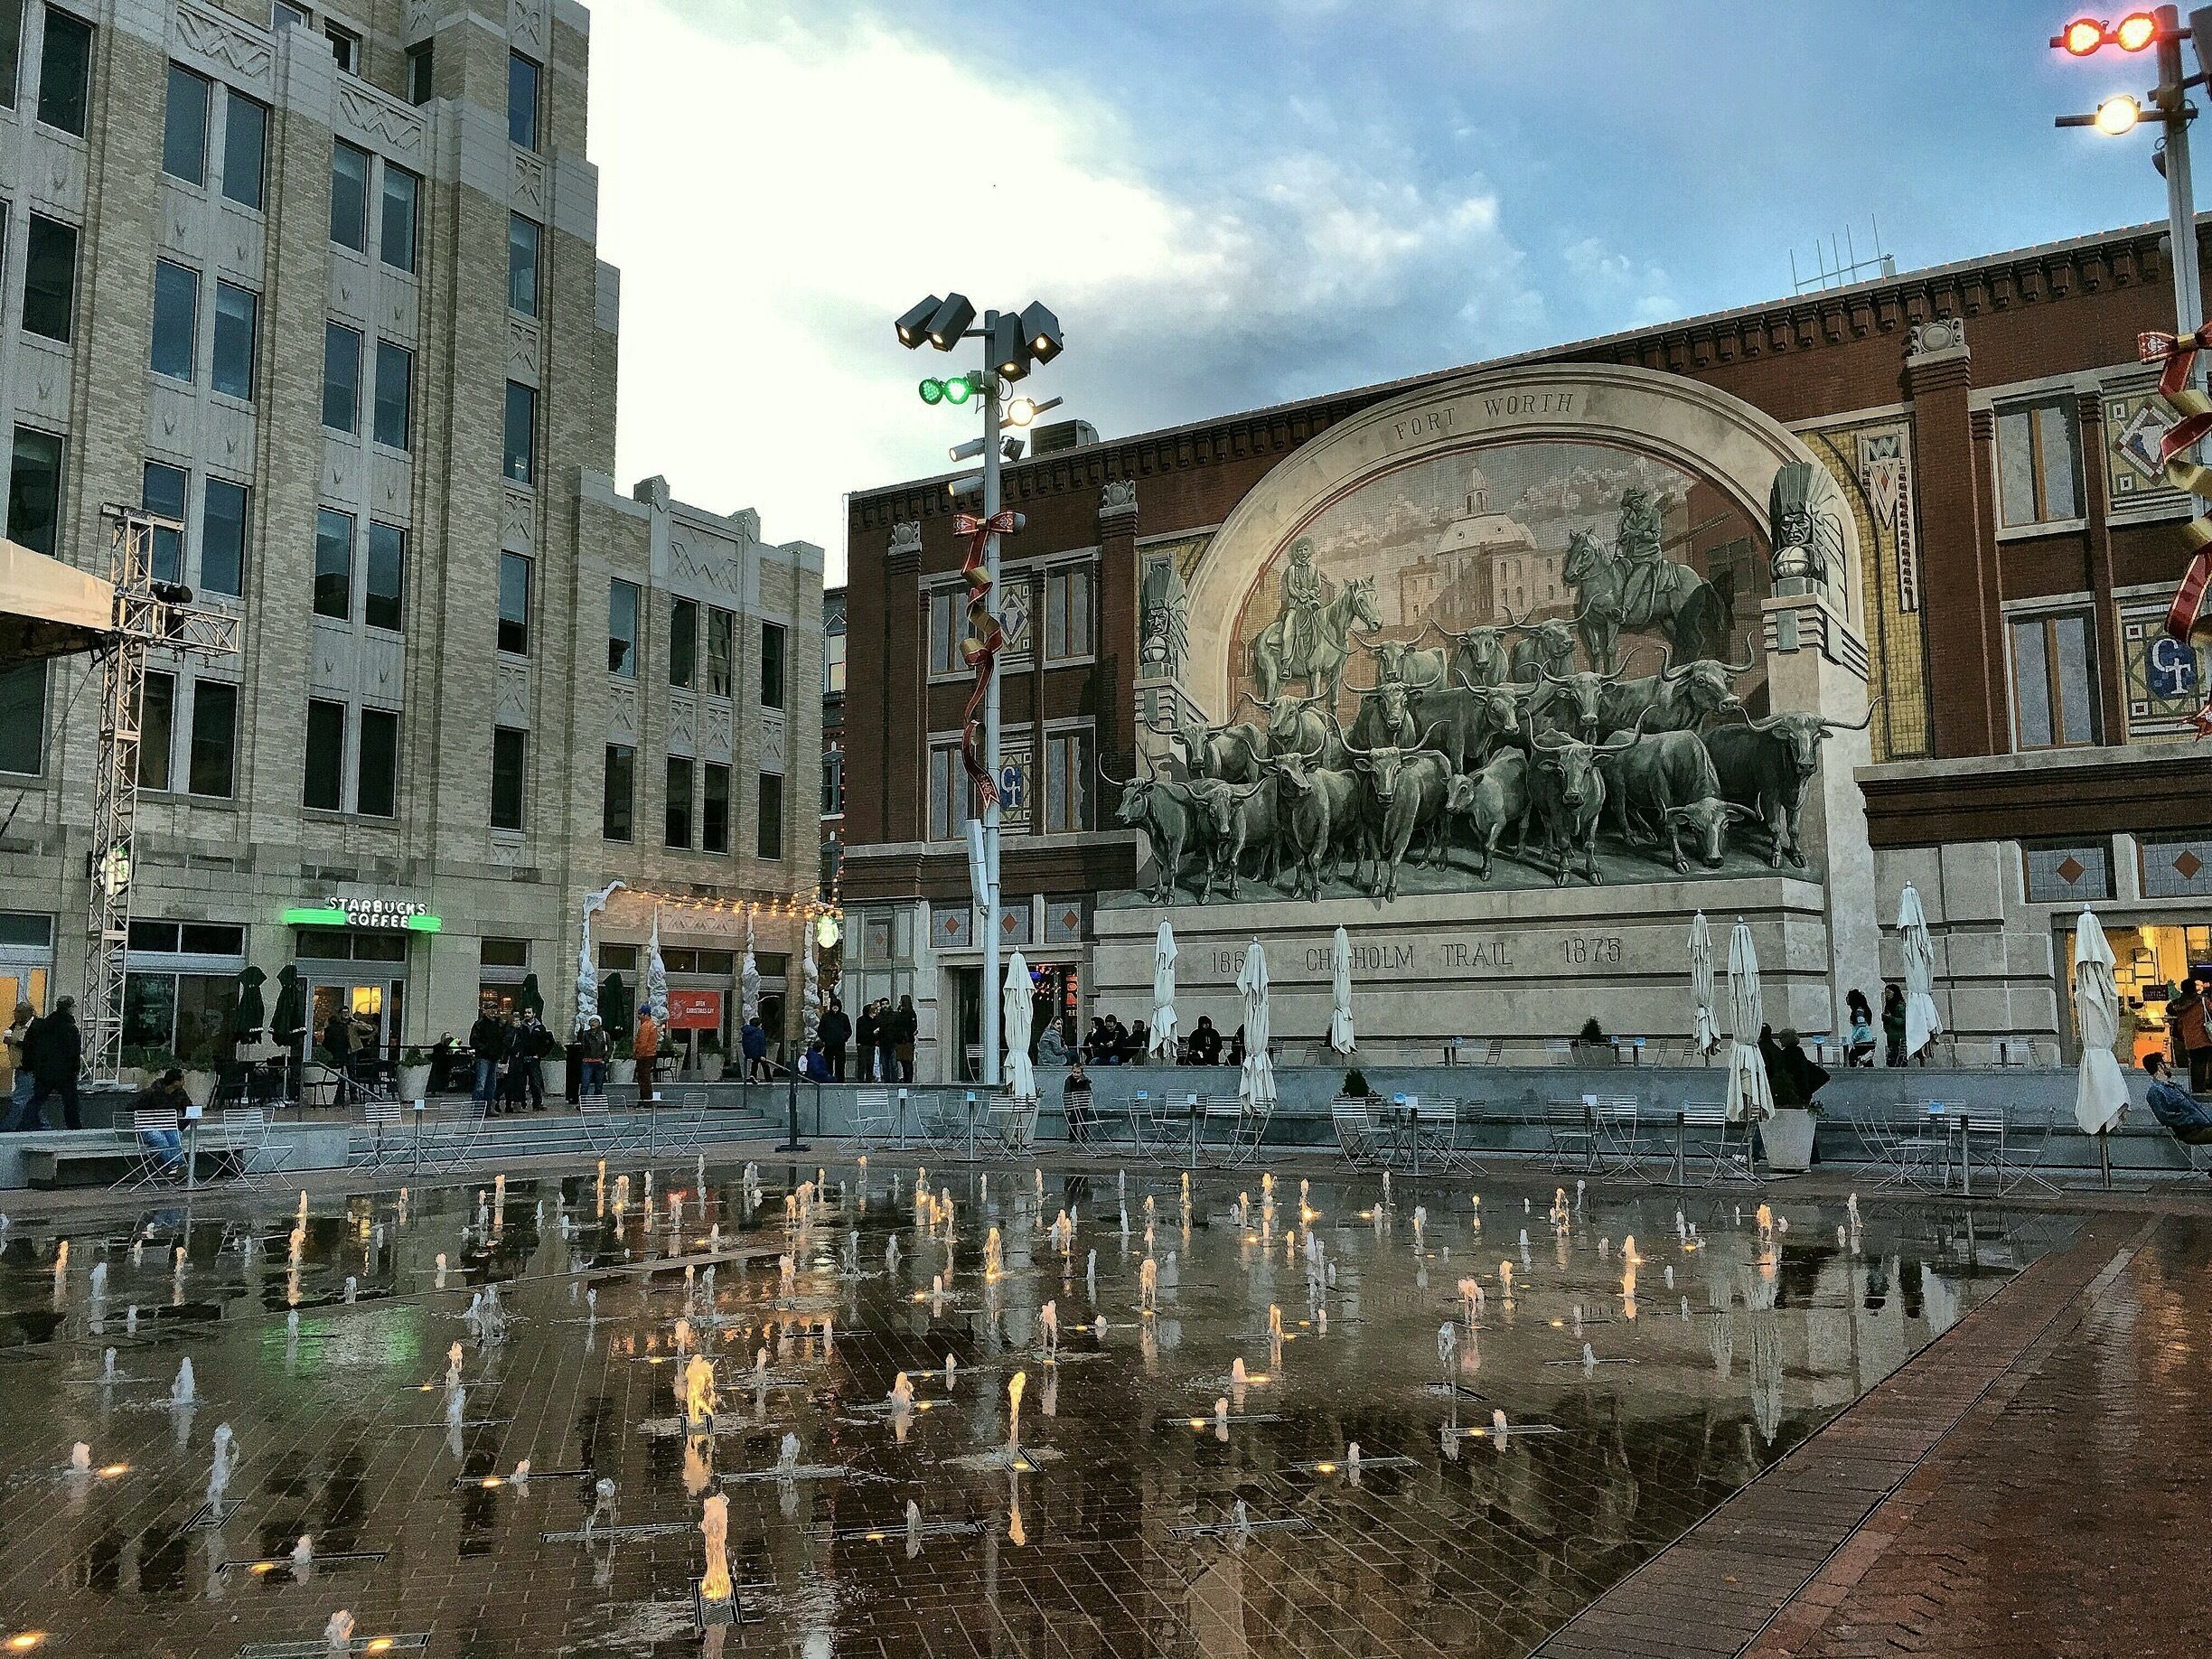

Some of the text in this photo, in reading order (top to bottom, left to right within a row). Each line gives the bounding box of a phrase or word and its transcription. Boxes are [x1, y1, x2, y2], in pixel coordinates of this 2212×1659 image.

[1393, 393, 1573, 441] FORT WORTH
[327, 896, 427, 916] STARBUCKS
[348, 912, 408, 929] COFFEE
[1212, 937, 1621, 973] 186 CHHOLM TRAIL 1875
